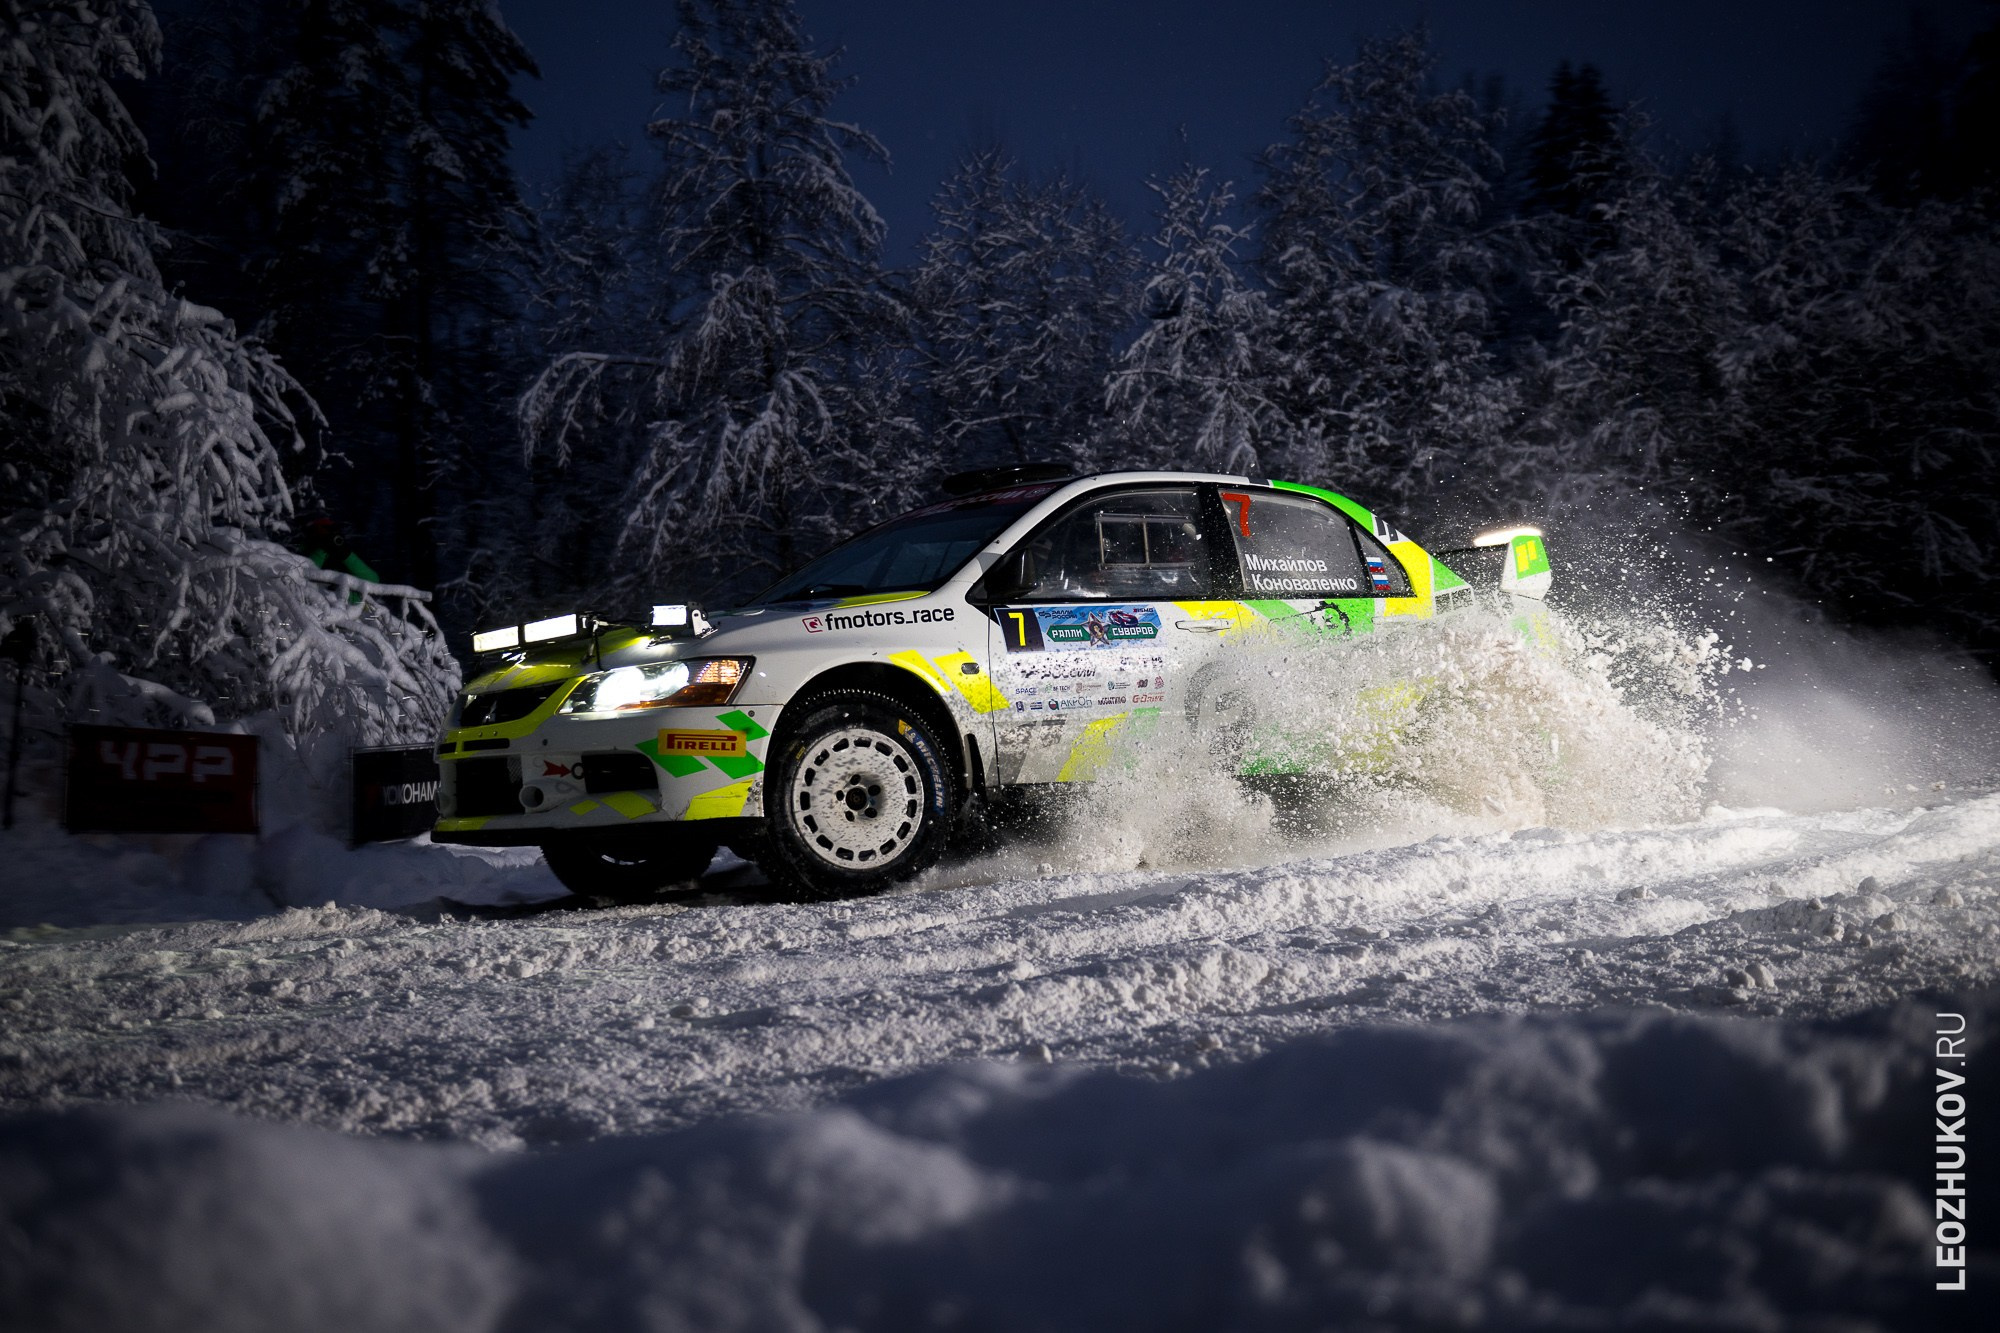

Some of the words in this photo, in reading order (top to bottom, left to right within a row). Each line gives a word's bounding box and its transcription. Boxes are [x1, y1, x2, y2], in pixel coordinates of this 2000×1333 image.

[1221, 492, 1251, 538] 7
[1245, 554, 1327, 572] Михайлов
[1251, 574, 1358, 591] Коноваленко
[825, 607, 955, 631] fmotors_race
[1008, 612, 1026, 647] 7
[1052, 628, 1083, 639] РАЛЛИ
[1112, 626, 1154, 637] СУВОРОВ
[666, 732, 738, 752] PIRELLI
[915, 739, 945, 809] MICHELIN
[383, 780, 442, 806] YOKOHAM
